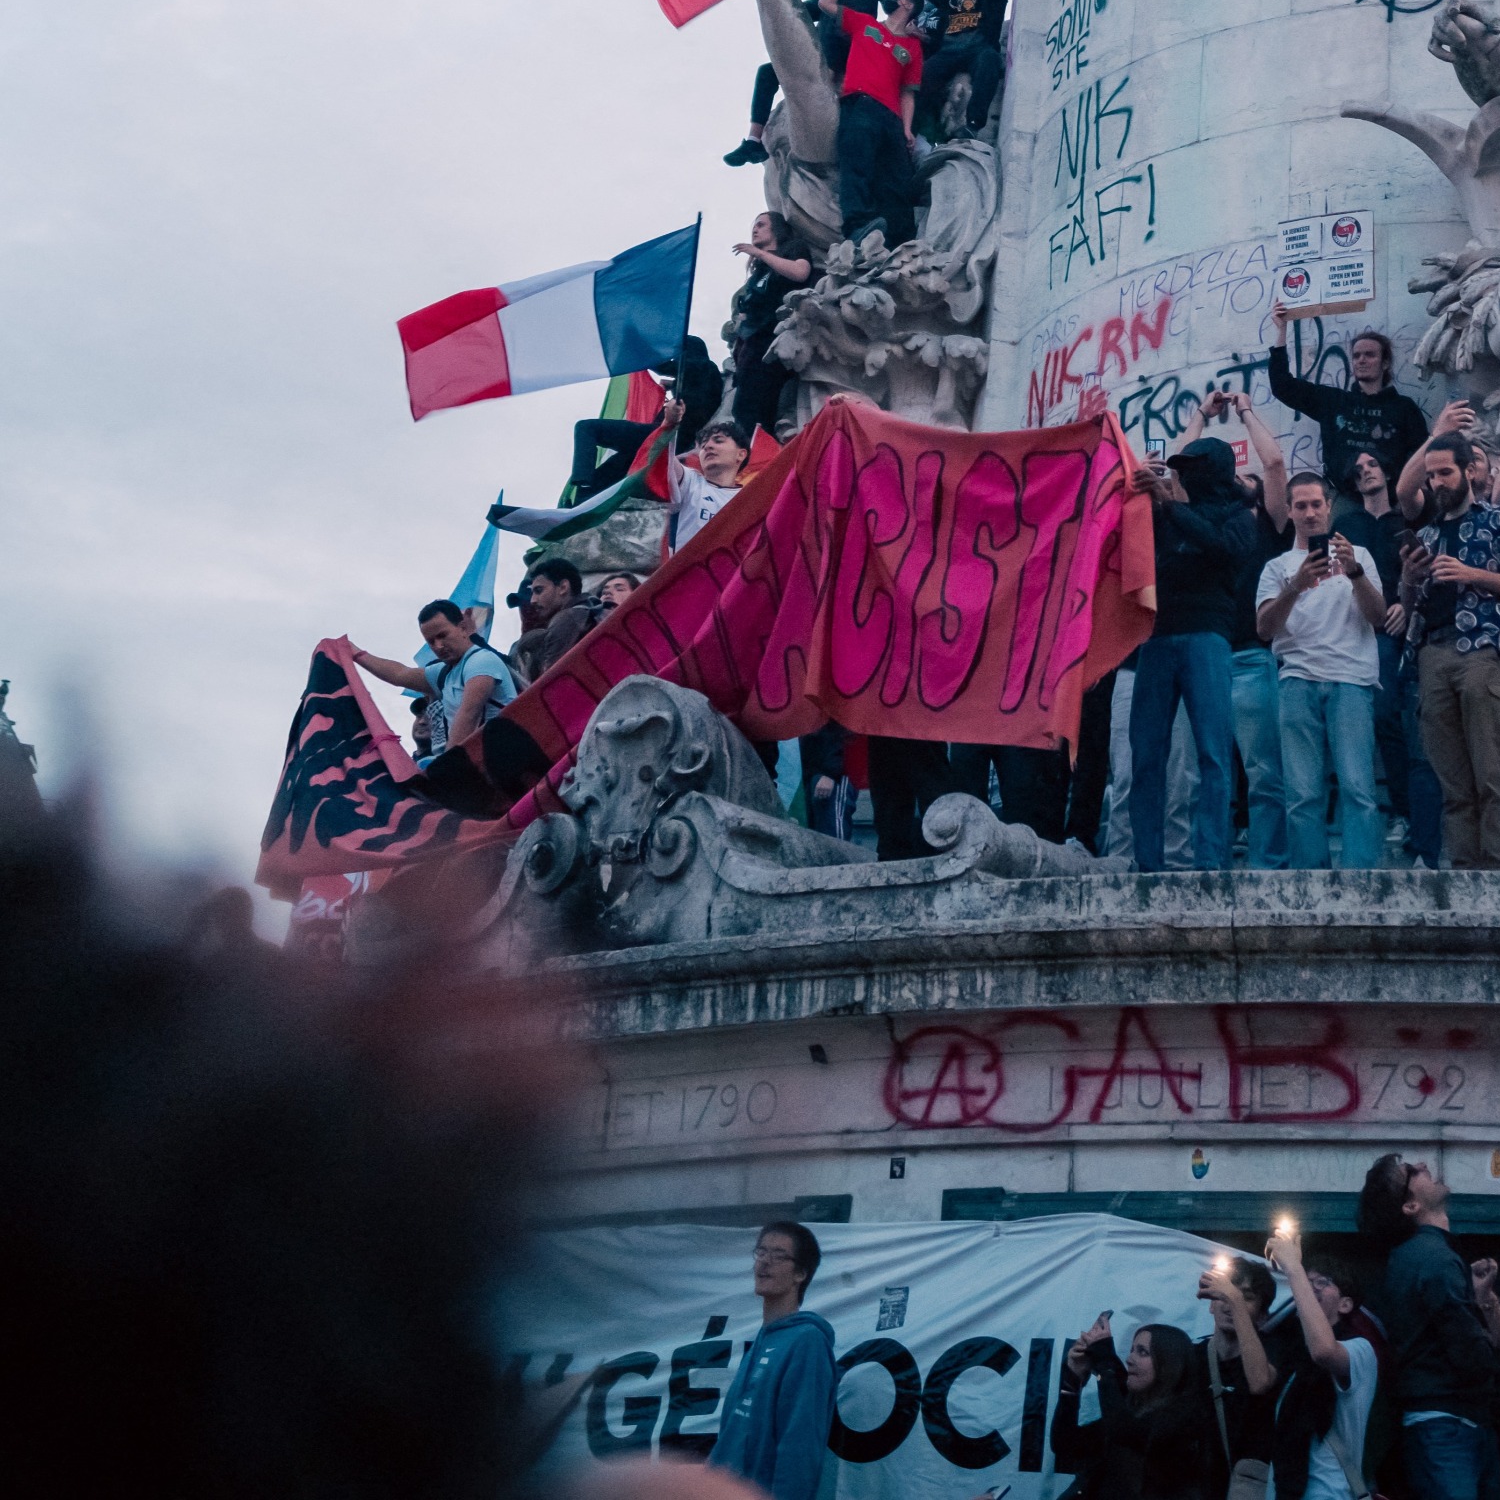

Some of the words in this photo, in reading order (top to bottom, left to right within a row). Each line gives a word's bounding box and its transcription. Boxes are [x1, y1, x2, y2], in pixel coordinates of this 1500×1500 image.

[1052, 29, 1090, 92] STE
[1054, 76, 1134, 188] NIK
[1097, 296, 1173, 378] RN
[677, 1079, 779, 1133] 1790
